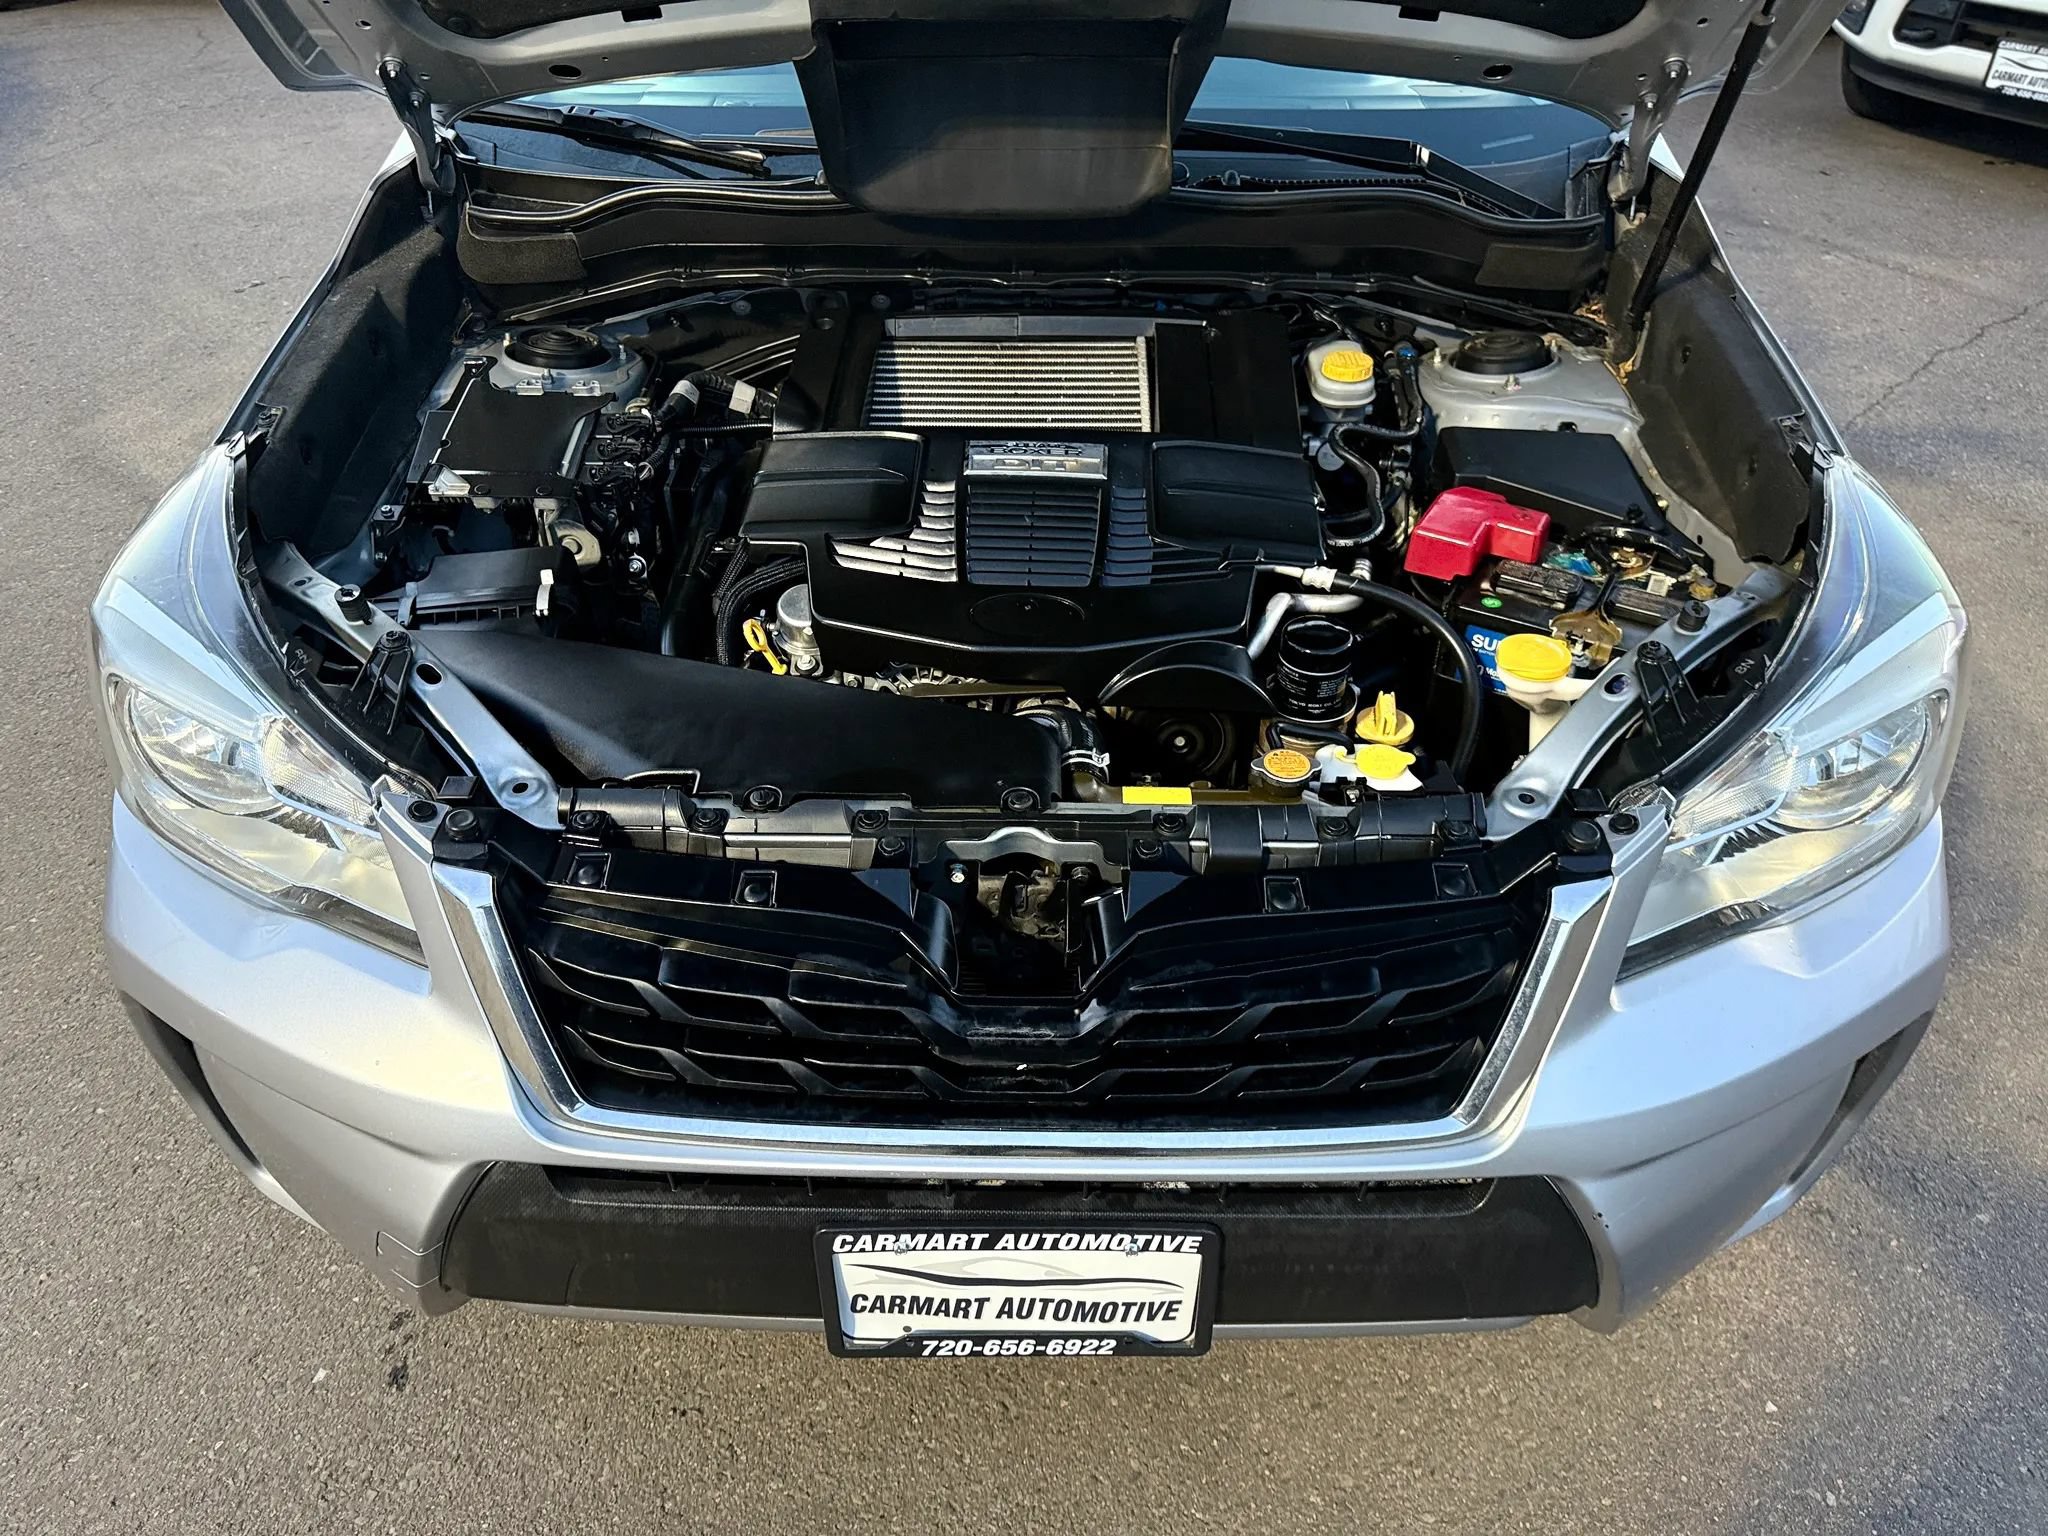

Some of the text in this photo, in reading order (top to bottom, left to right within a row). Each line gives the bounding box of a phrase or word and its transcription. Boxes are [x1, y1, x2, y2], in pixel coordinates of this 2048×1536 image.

[1992, 69, 2029, 85] CARMART
[1471, 634, 1500, 652] SU
[832, 1233, 1202, 1254] CARMART AUTOMOTIVE
[850, 1293, 1183, 1323] CARMART AUTOMOTIVE
[921, 1338, 1117, 1356] 720-656-6922
